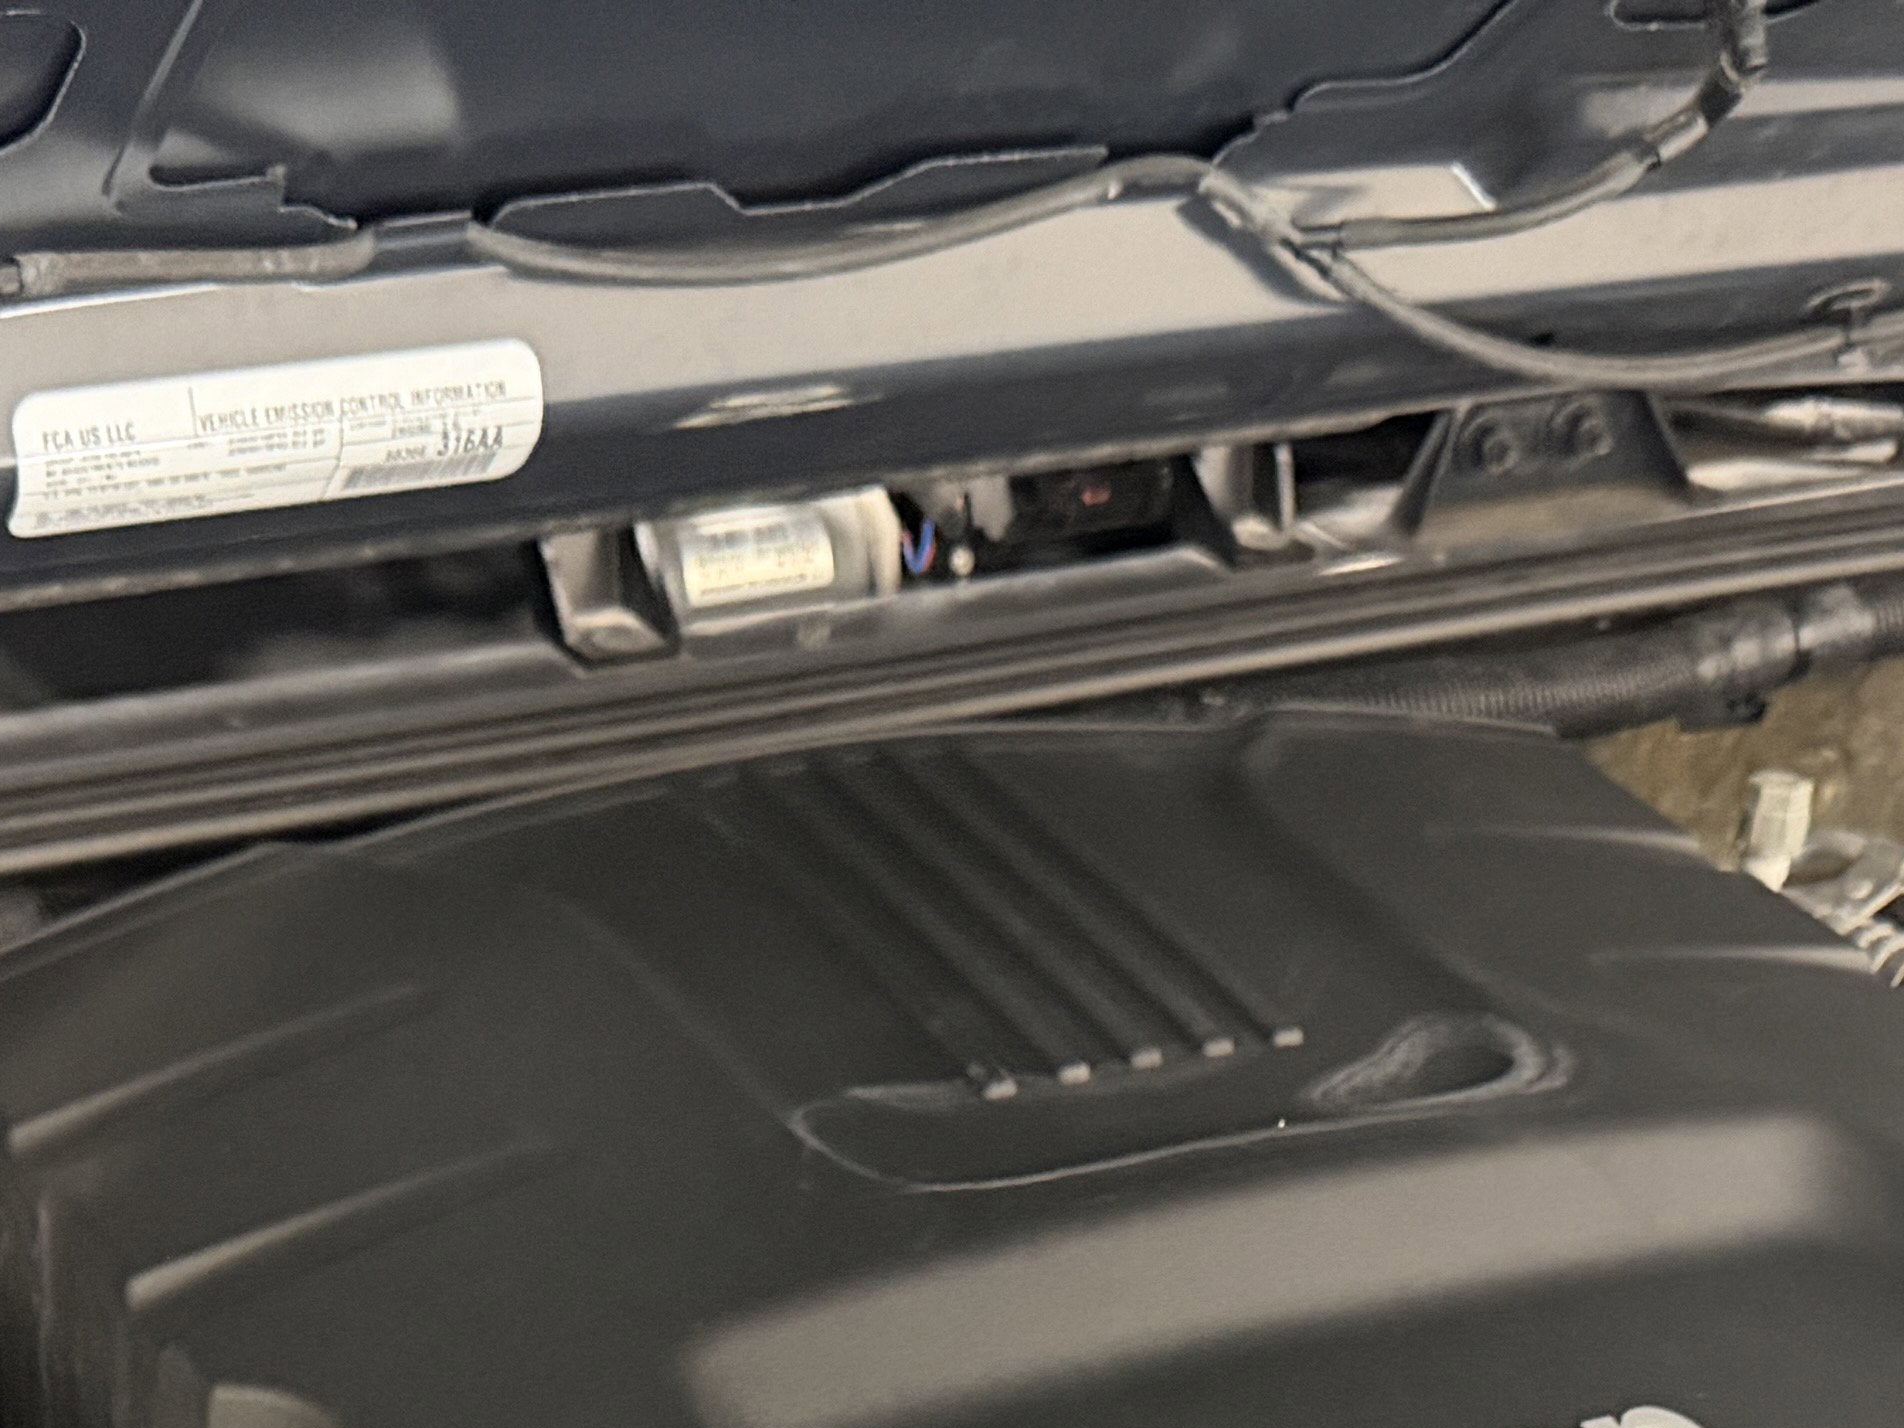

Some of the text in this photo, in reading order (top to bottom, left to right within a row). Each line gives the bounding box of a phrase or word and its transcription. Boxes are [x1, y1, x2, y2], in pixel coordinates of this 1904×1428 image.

[198, 408, 257, 433] VEHICLE
[264, 400, 334, 426] EMISSION
[342, 391, 403, 416] CONTROL
[411, 380, 506, 405] INFORMATION
[42, 422, 136, 452] FCA US LLC
